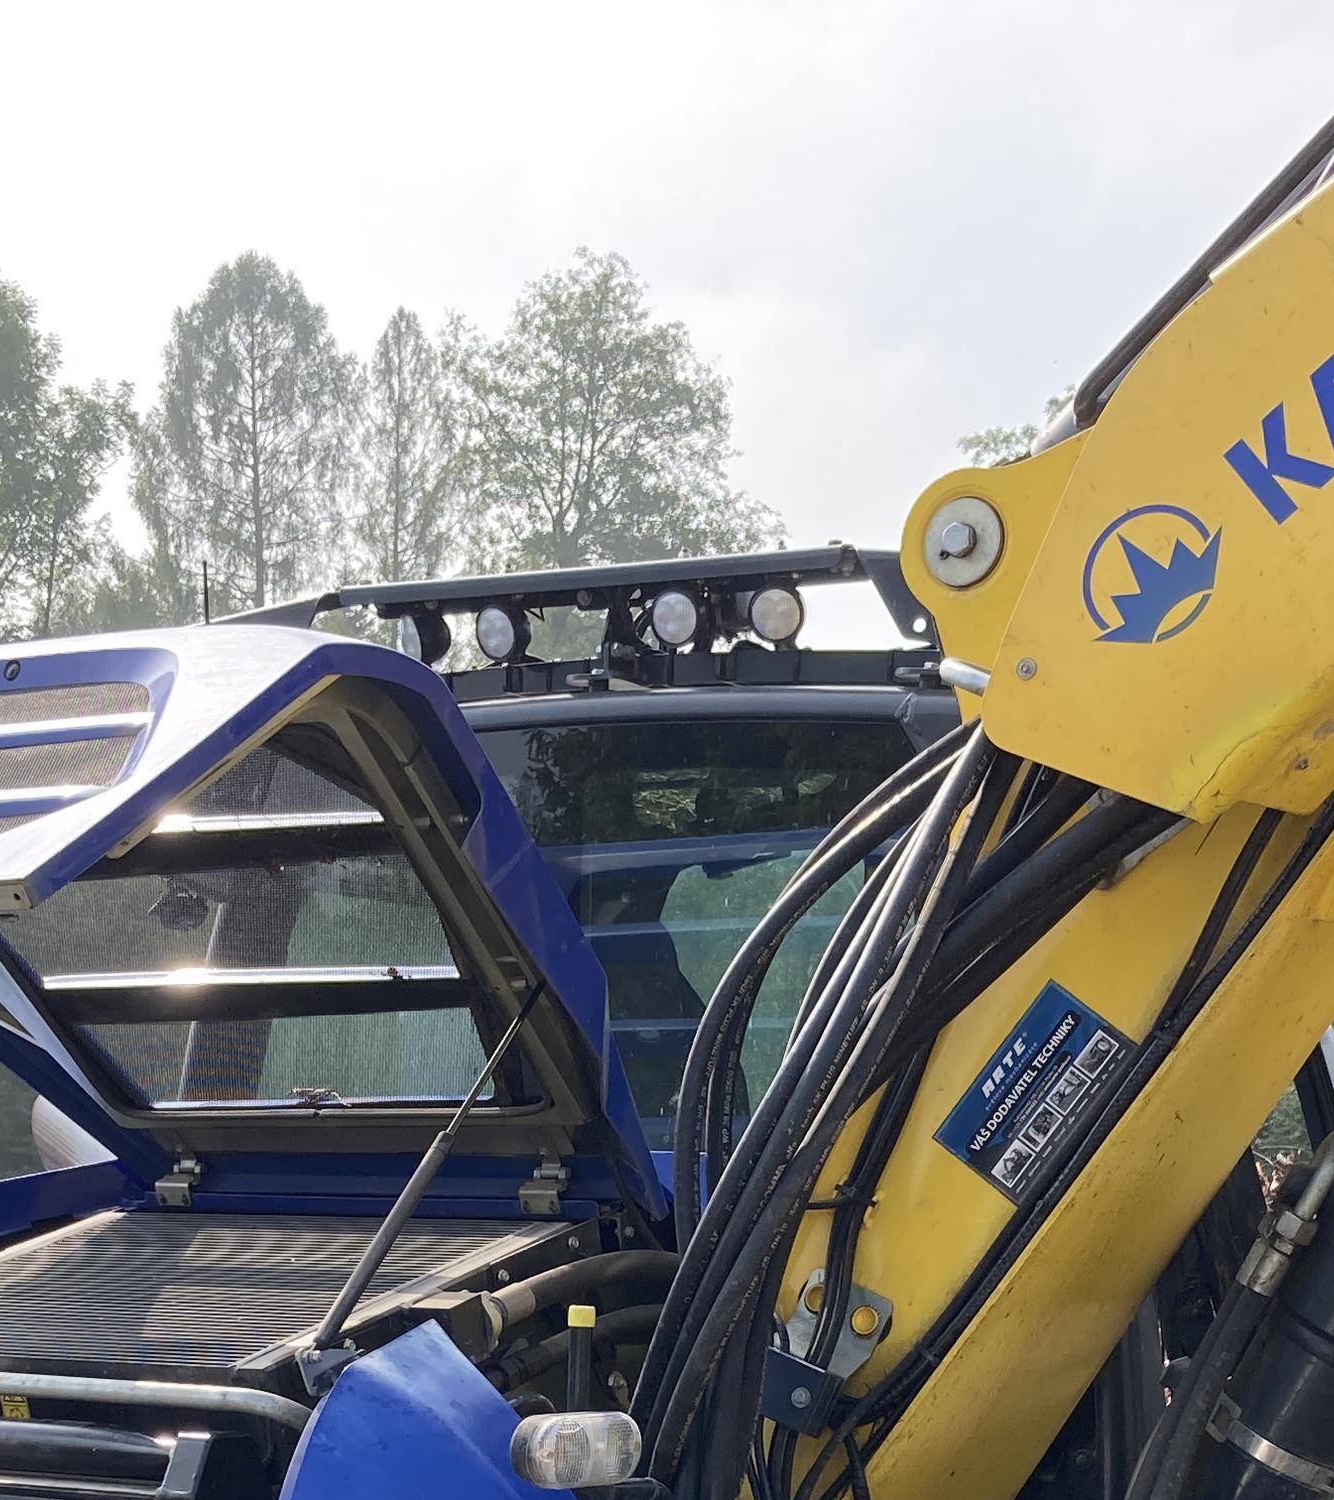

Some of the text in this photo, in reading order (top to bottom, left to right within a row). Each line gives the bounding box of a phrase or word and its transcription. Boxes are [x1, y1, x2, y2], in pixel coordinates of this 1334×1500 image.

[970, 1124, 991, 1152] VÁŠ
[986, 1069, 1038, 1131] DODAVATEL
[1031, 1014, 1076, 1069] TECHNIKY
[982, 1037, 1026, 1098] ARTE
